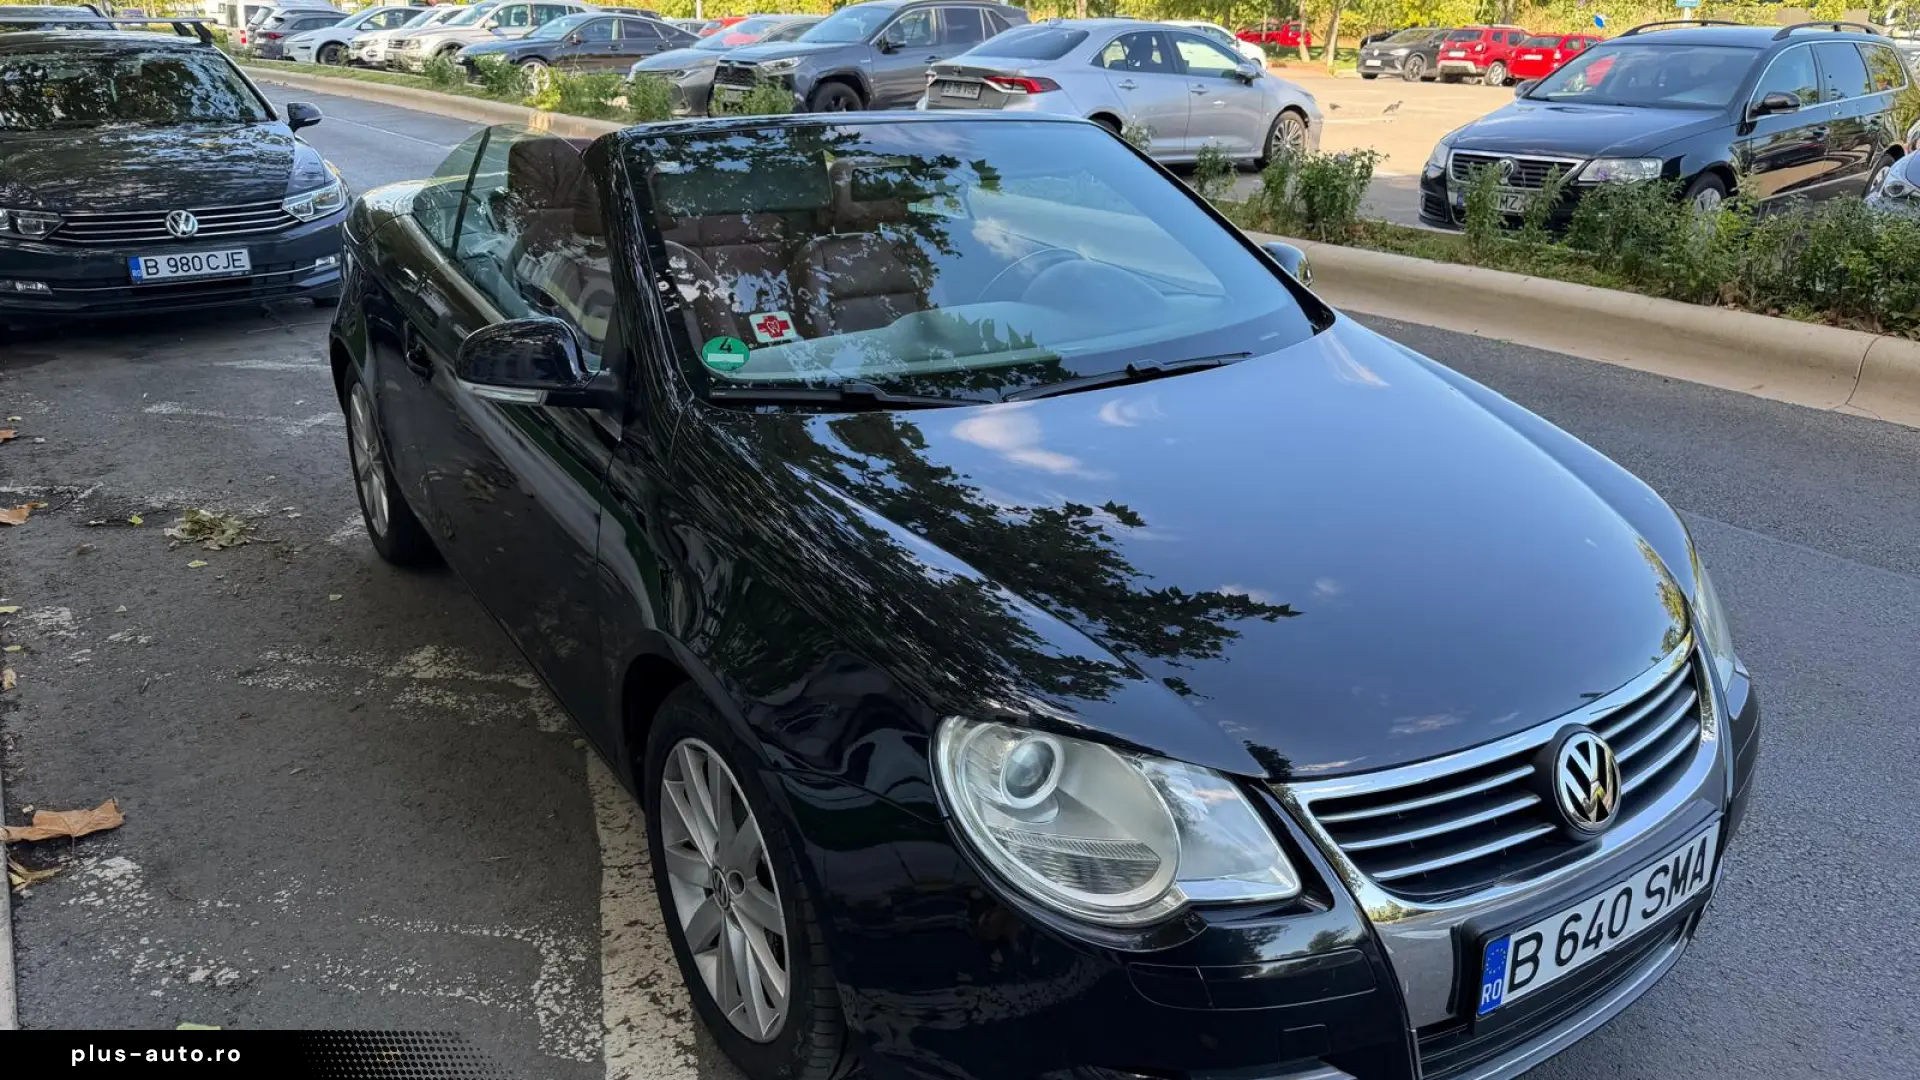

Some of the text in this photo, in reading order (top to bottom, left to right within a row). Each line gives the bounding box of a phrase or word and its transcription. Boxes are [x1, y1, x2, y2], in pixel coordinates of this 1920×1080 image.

[166, 210, 197, 237] VW
[143, 251, 246, 276] B 980 CJE
[719, 337, 733, 353] 4
[1559, 733, 1619, 829] VW
[1507, 835, 1708, 994] B 640 SMA
[1481, 978, 1503, 1006] RO
